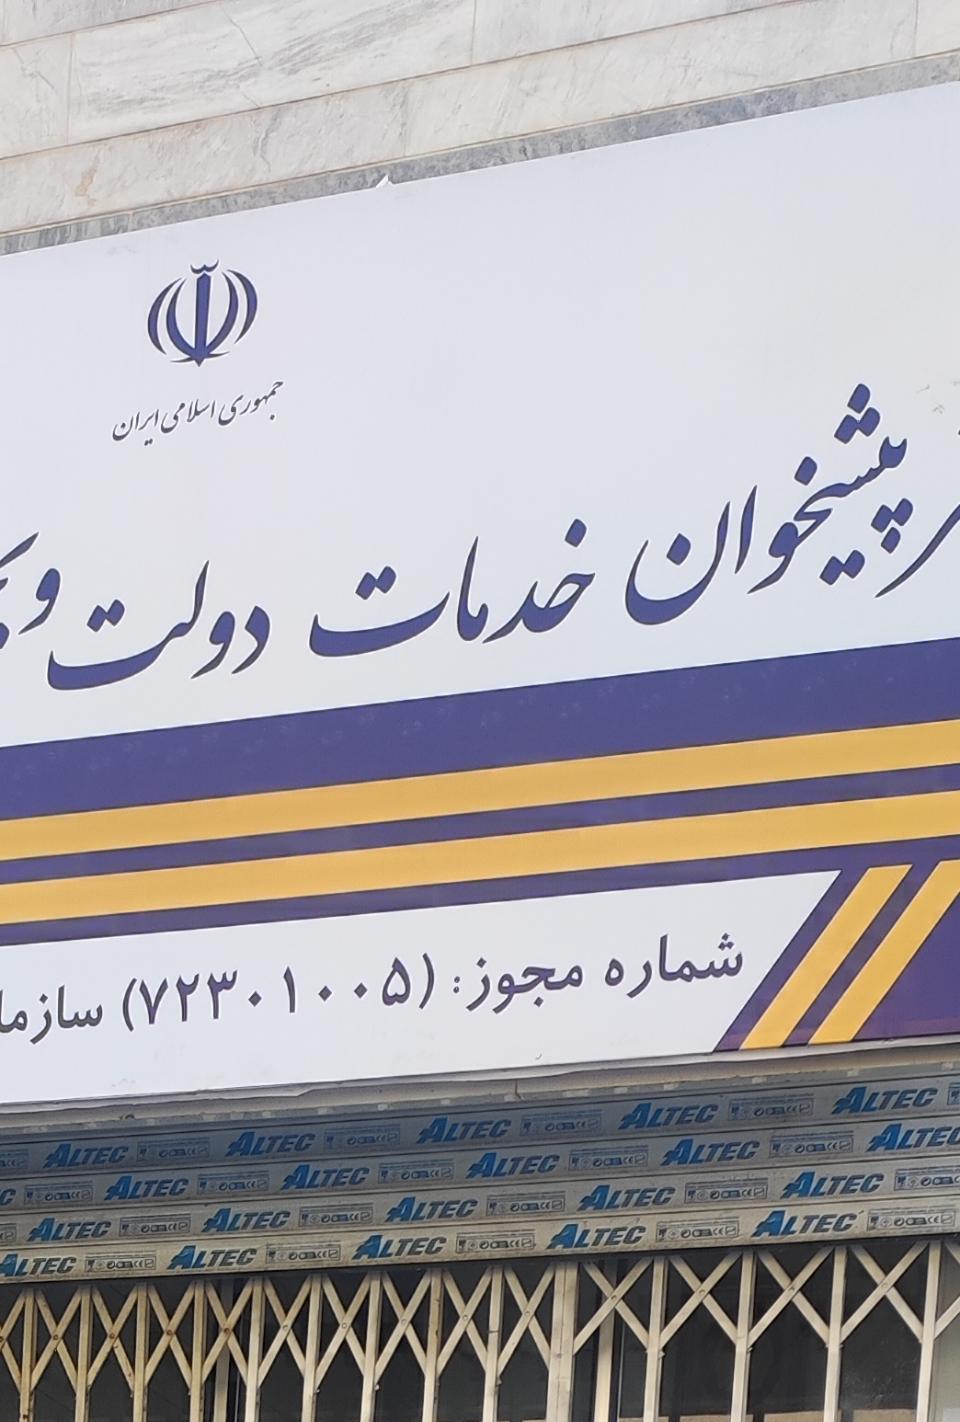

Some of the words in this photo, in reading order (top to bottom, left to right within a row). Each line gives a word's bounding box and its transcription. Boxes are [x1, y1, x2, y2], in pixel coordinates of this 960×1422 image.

[112, 408, 160, 446] ایران
[160, 399, 216, 433] اسلامی
[218, 381, 283, 426] جمهوری
[625, 383, 914, 626] پیشخوان
[309, 518, 596, 657] خدمات
[47, 561, 271, 691] دولت
[453, 956, 582, 1014] مجوز:
[604, 932, 743, 999] شماره
[43, 1143, 129, 1169] ALTEC
[225, 1131, 315, 1158] ALTEC
[415, 1116, 512, 1144] ALTEC
[618, 1103, 719, 1131] ALTEC
[831, 1086, 938, 1115] ALTEC
[105, 1176, 189, 1201] ALTEC
[281, 1164, 370, 1190] ALTEC
[465, 1151, 561, 1179] ALTEC
[661, 1138, 760, 1166] ALTEC
[27, 1217, 111, 1242] ALTEC
[202, 1207, 291, 1233] ALTEC
[383, 1197, 477, 1224] ALTEC
[577, 1185, 677, 1211] ALTEC
[781, 1171, 885, 1198] ALTEC
[167, 1245, 258, 1270] ALTEC
[353, 1234, 447, 1260] ALTEC
[547, 1224, 647, 1250] ALTEC
[751, 1211, 857, 1237] ALTEC
